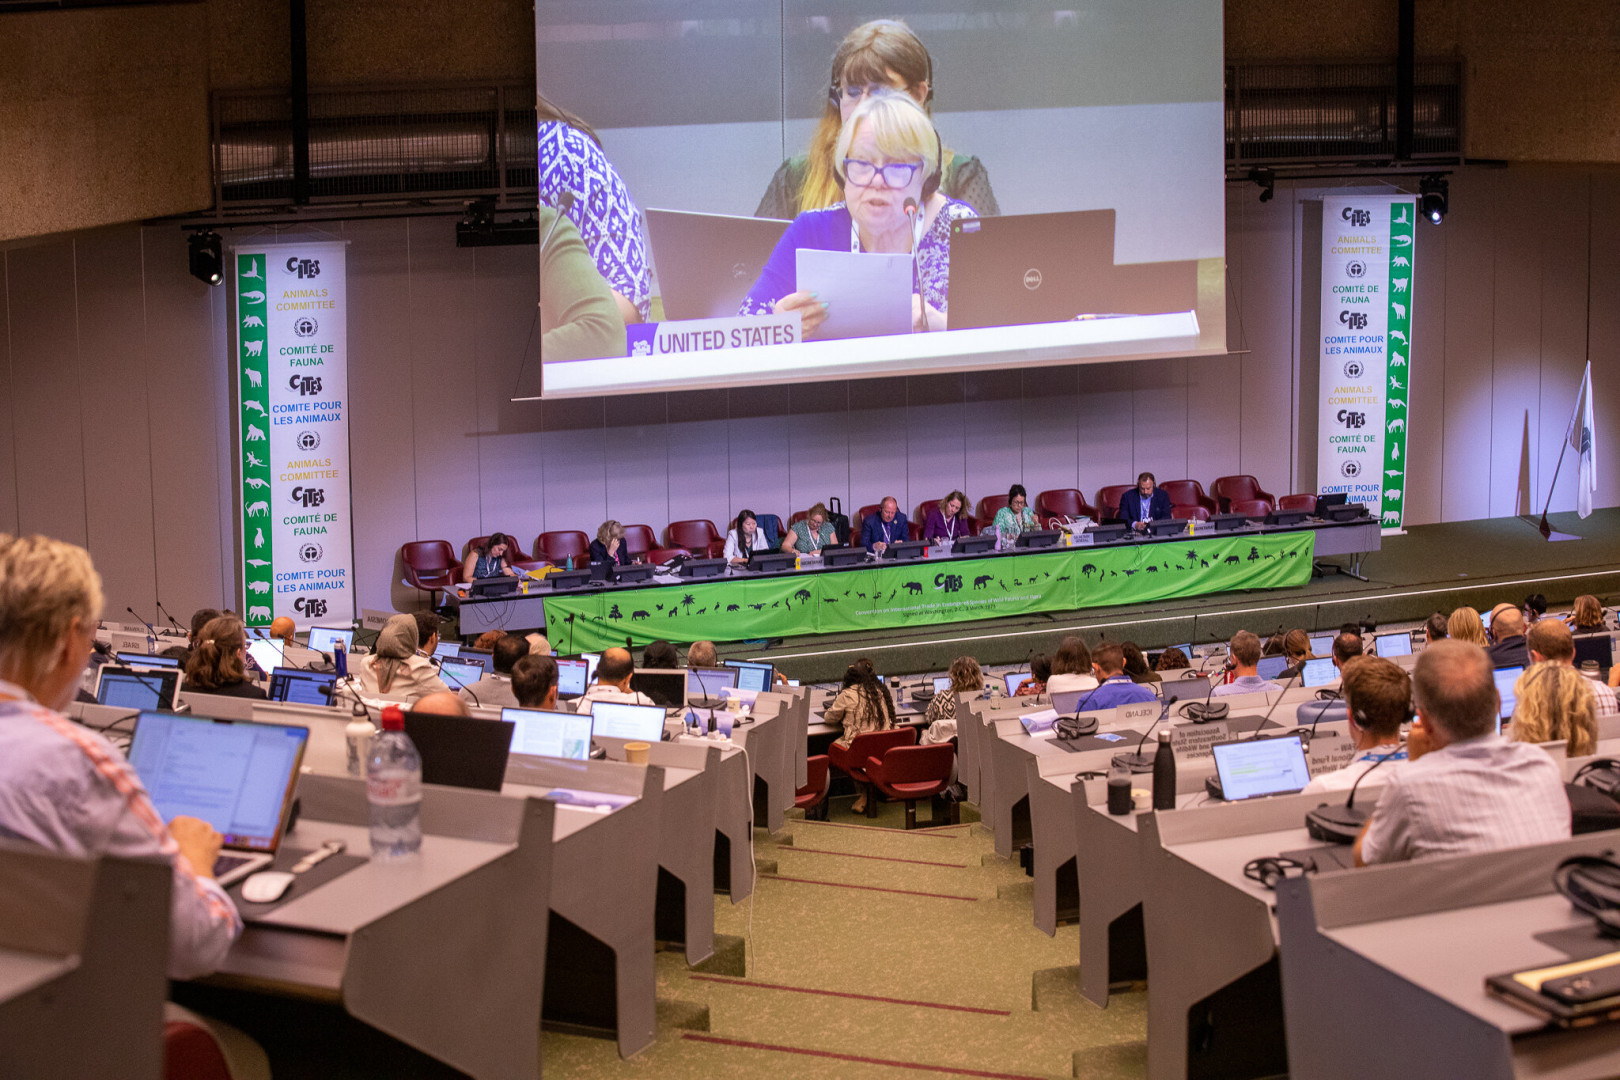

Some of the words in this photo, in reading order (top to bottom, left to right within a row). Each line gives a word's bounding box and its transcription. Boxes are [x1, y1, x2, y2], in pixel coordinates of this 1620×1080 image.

[1341, 207, 1370, 227] CITES
[1337, 236, 1376, 244] ANIMALS
[1331, 246, 1382, 255] COMMITTEE
[286, 256, 320, 279] CITES
[283, 288, 328, 299] ANIMALS
[1332, 284, 1365, 293] COMITÉ
[1367, 285, 1379, 293] DE
[276, 300, 336, 311] COMMITTEE
[1340, 296, 1370, 304] FAUNA
[1339, 310, 1367, 330] CITES
[659, 330, 725, 354] UNITED
[730, 324, 794, 348] STATES
[1324, 336, 1357, 344] COMITE
[1359, 335, 1384, 343] POUR
[279, 344, 317, 356] COMITÉ
[320, 344, 334, 353] DE
[1325, 347, 1341, 355] LES
[1343, 346, 1383, 354] ANIMAUX
[289, 357, 324, 367] FAUNA
[289, 374, 323, 396] CITES
[1334, 386, 1373, 394] ANIMALS
[1328, 397, 1378, 405] COMMITTEE
[272, 402, 311, 414] COMITE
[313, 401, 342, 410] POUR
[273, 416, 293, 425] LES
[295, 413, 341, 424] ANIMAUX
[1337, 409, 1366, 429] CITES
[1329, 434, 1361, 443] COMITÉ
[1364, 435, 1376, 443] DE
[1337, 446, 1366, 454] FAUNA
[286, 458, 331, 469] ANIMALS
[280, 470, 339, 482] COMMITTEE
[1321, 485, 1353, 494] COMITE
[1355, 484, 1379, 492] POUR
[292, 486, 325, 508] CITES
[1345, 495, 1378, 503] NIMAUX
[283, 512, 321, 525] COMITÉ
[323, 513, 338, 522] DE
[294, 525, 328, 536] FAUNA
[276, 570, 314, 581] COMITE
[317, 568, 346, 578] POUR
[277, 584, 297, 593] LES
[299, 580, 345, 591] ANIMAUX
[934, 573, 963, 592] CITES
[294, 597, 328, 618] CITES
